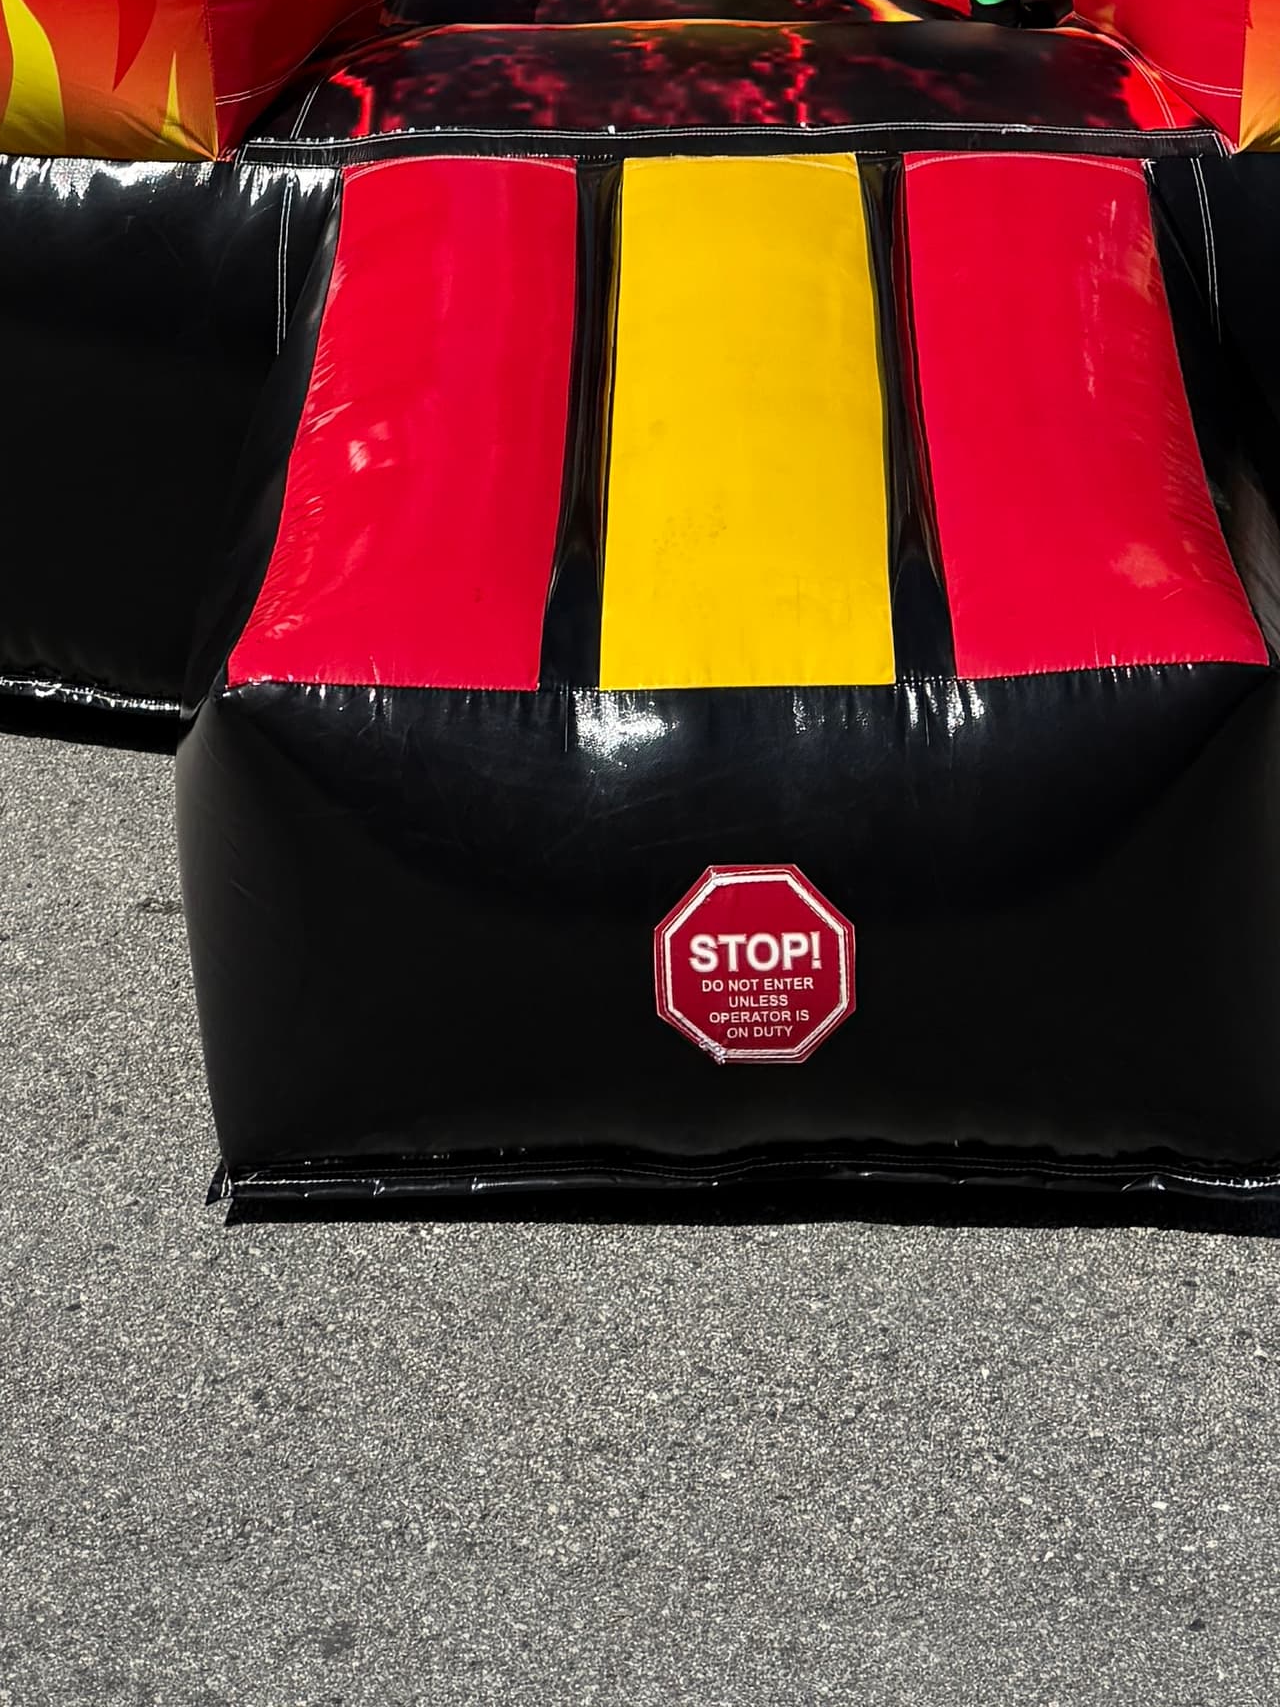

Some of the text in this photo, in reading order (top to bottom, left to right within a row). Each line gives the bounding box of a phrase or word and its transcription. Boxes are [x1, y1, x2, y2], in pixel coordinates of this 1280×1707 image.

[688, 931, 822, 973] STOP!
[702, 977, 814, 992] DO NOT ENTER
[729, 994, 788, 1008] UNLESS
[709, 1009, 809, 1024] OPERATOR IS
[726, 1025, 793, 1039] ON DUTY
